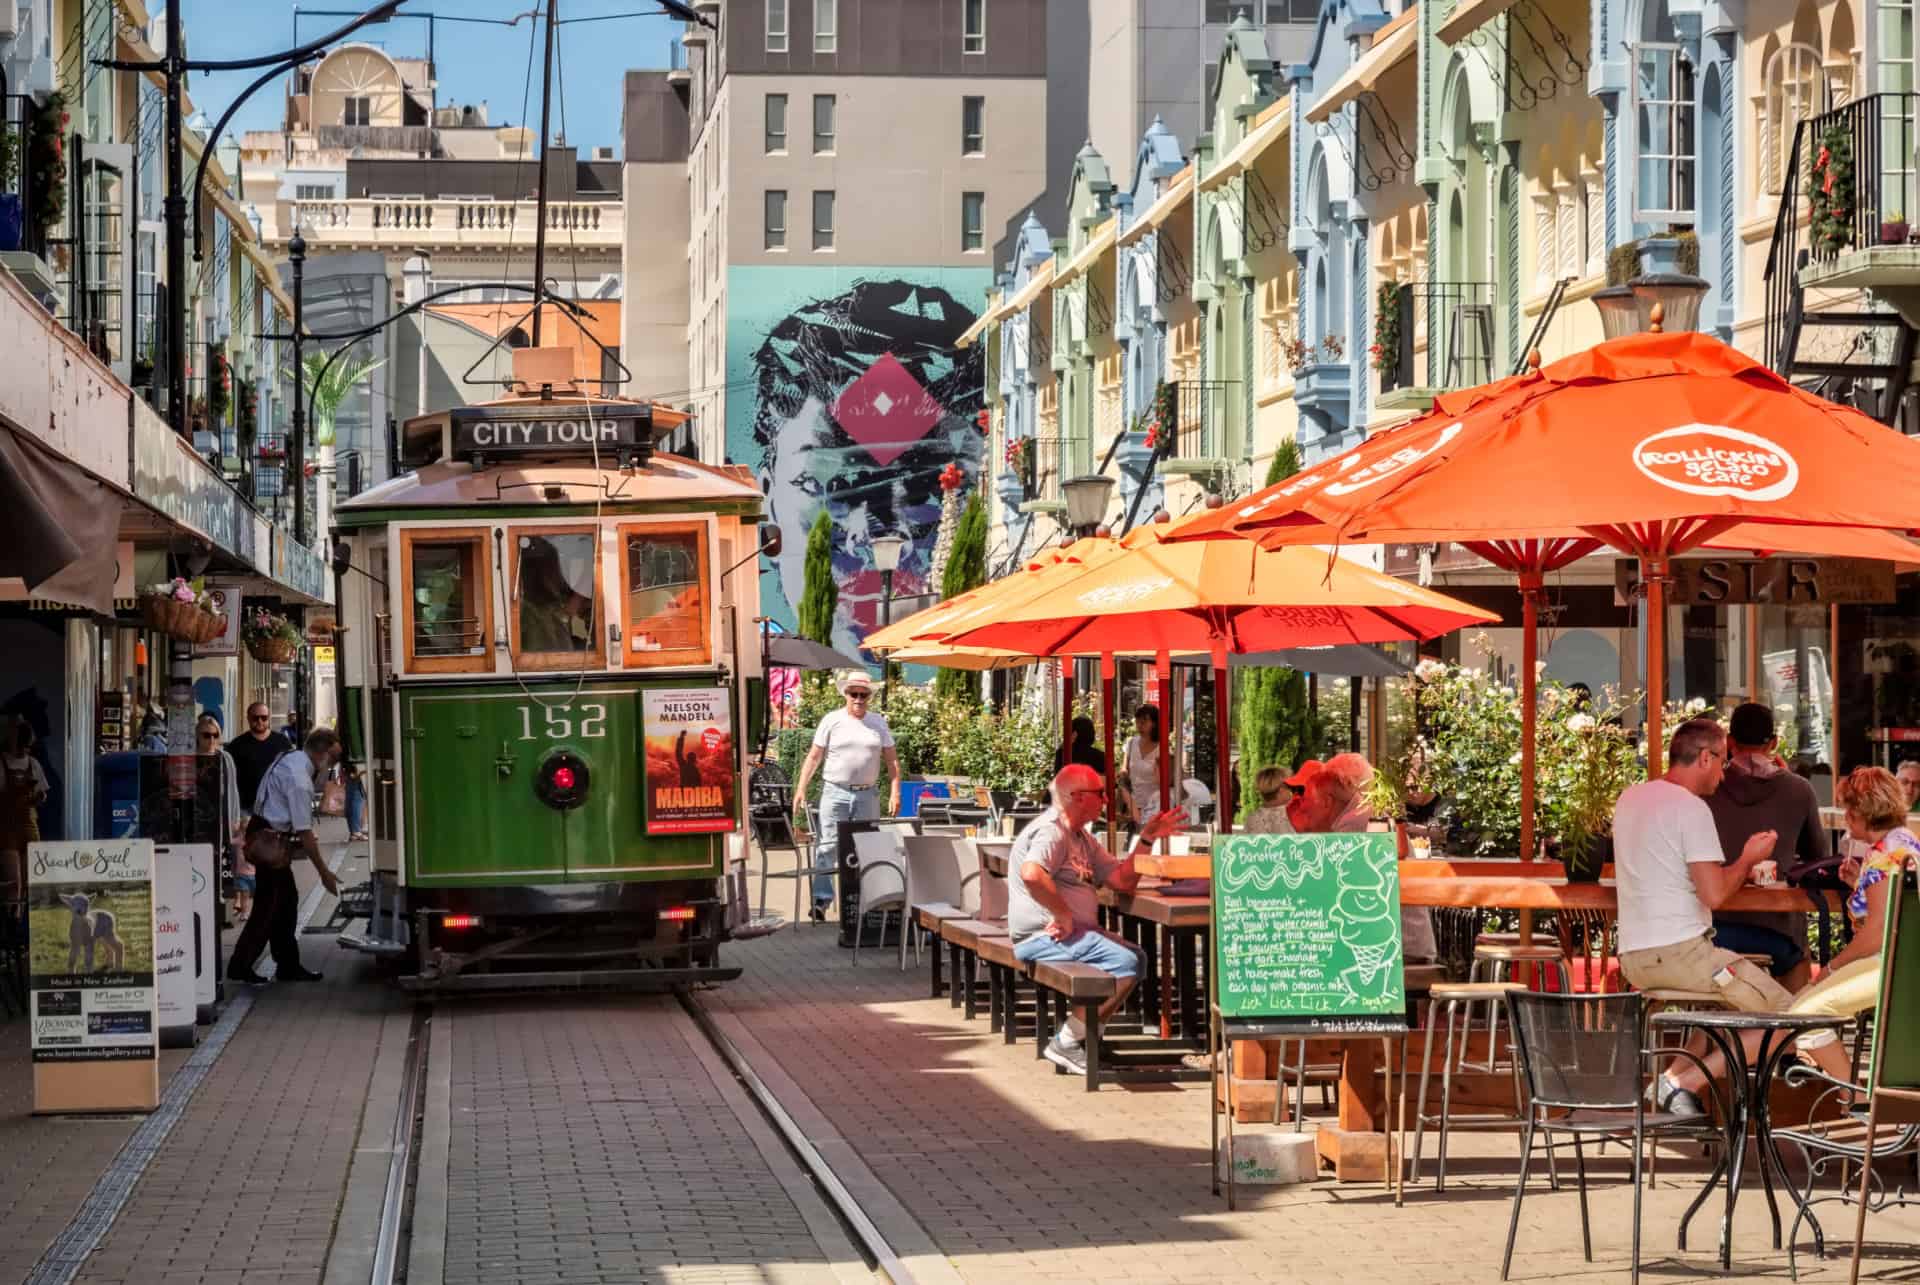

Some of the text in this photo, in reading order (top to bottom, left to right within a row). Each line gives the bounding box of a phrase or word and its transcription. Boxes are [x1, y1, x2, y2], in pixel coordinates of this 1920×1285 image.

[473, 420, 618, 445] CITY TOUR
[664, 702, 710, 713] NELSON
[516, 704, 607, 741] 152
[659, 712, 715, 722] MANDELA
[656, 786, 723, 809] MADIBA
[94, 847, 131, 874] Soul
[108, 870, 148, 878] GALLERY
[83, 976, 100, 985] New
[103, 975, 135, 985] Zealand
